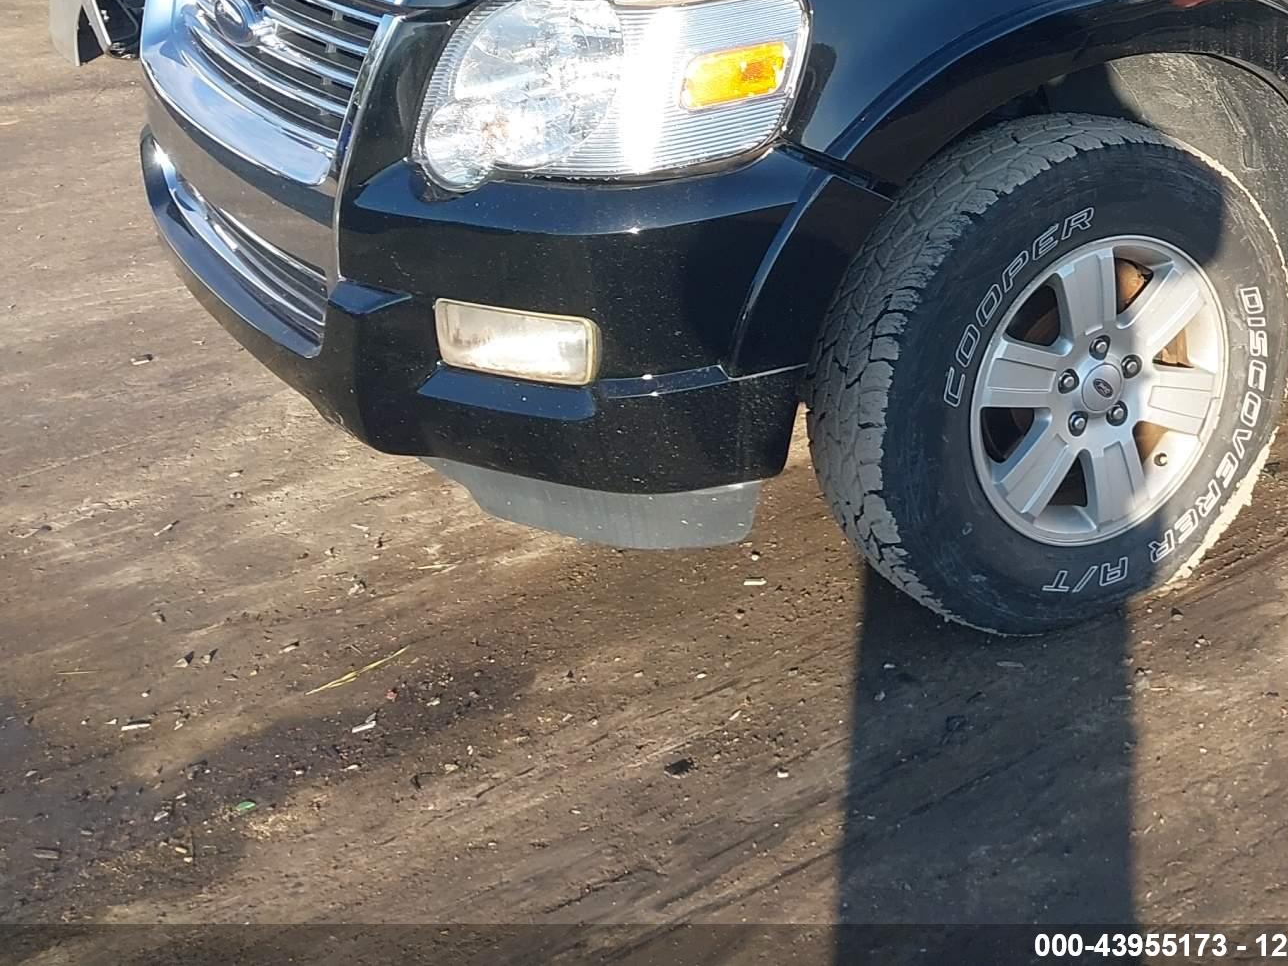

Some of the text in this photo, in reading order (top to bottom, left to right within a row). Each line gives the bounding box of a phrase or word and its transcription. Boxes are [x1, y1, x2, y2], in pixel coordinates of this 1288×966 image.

[943, 206, 1095, 409] COOPER
[1041, 285, 1270, 595] DISCOVERER A/T
